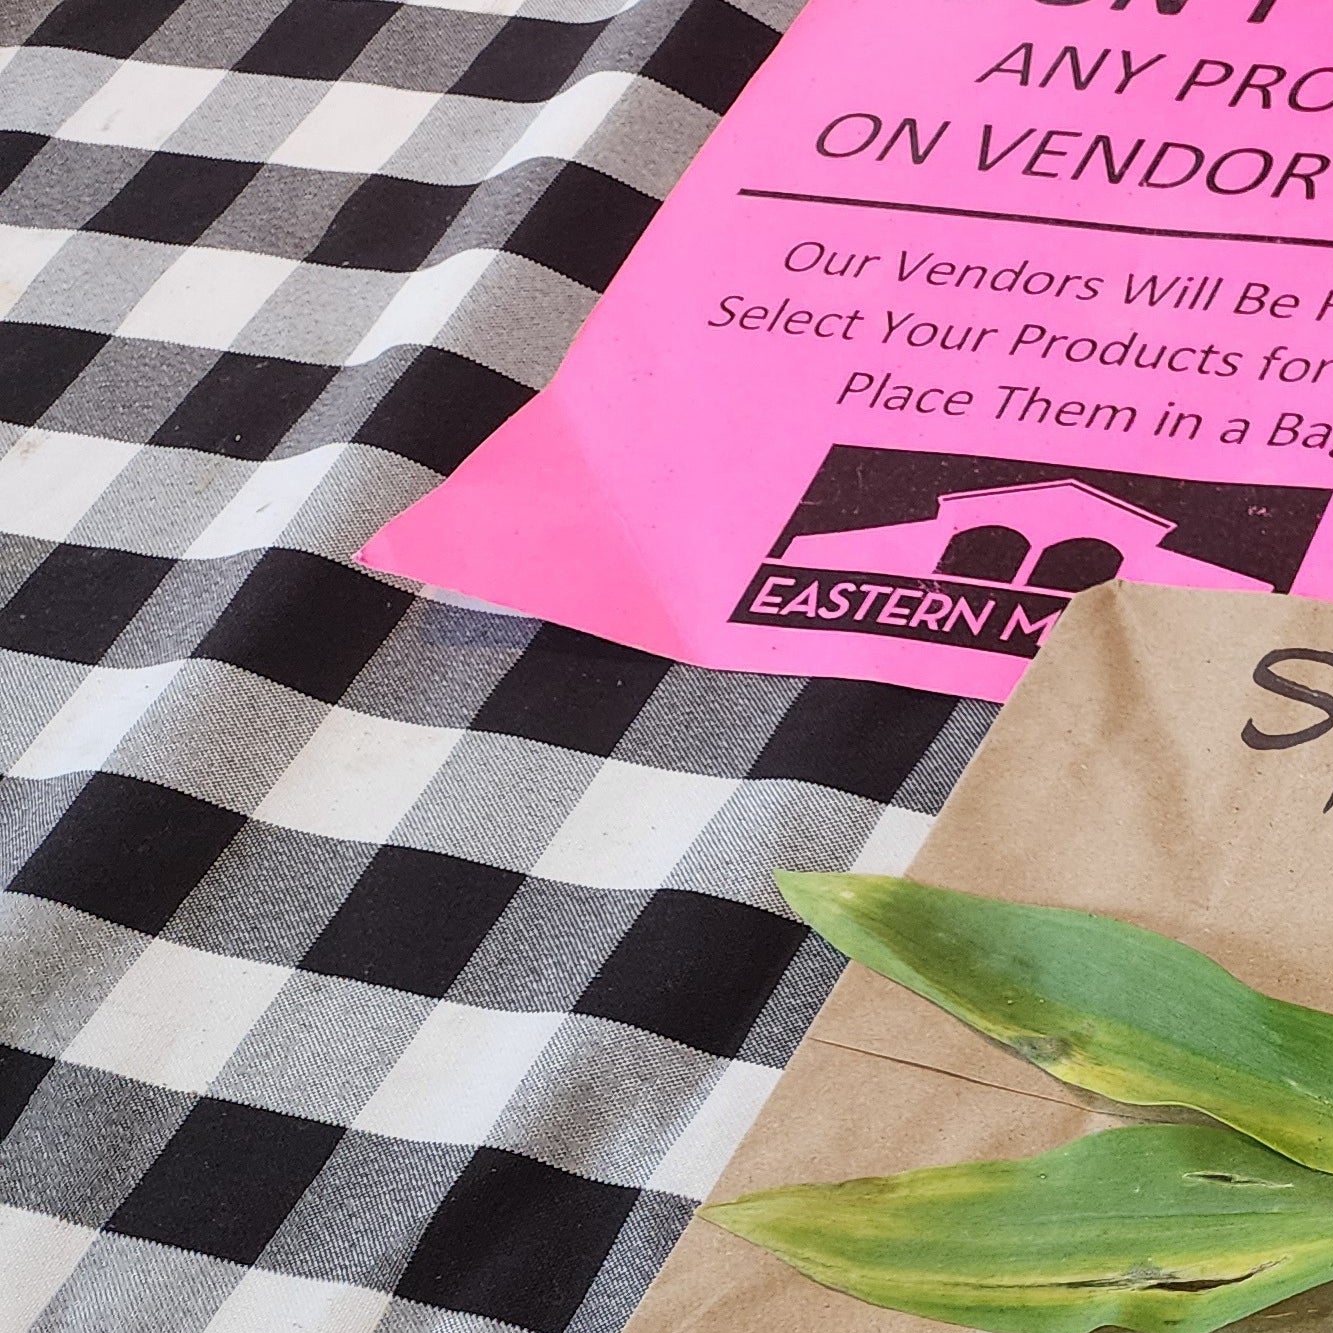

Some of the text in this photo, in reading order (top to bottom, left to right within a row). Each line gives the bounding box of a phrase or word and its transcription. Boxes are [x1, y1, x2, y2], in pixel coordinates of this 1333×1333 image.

[975, 43, 1166, 94] ANY
[816, 113, 951, 164] ON
[978, 125, 1331, 200] VENDOR
[785, 242, 881, 277] Our
[898, 251, 1104, 300] Vendors
[1125, 273, 1223, 310] Will
[1234, 283, 1299, 318] Be
[708, 296, 864, 340] Select
[882, 311, 998, 352] Your
[1009, 324, 1243, 376] Products
[837, 372, 973, 415] Place
[996, 386, 1136, 432] Them
[1154, 402, 1202, 439] in
[1220, 419, 1250, 444] a
[750, 577, 995, 635] EASTERN
